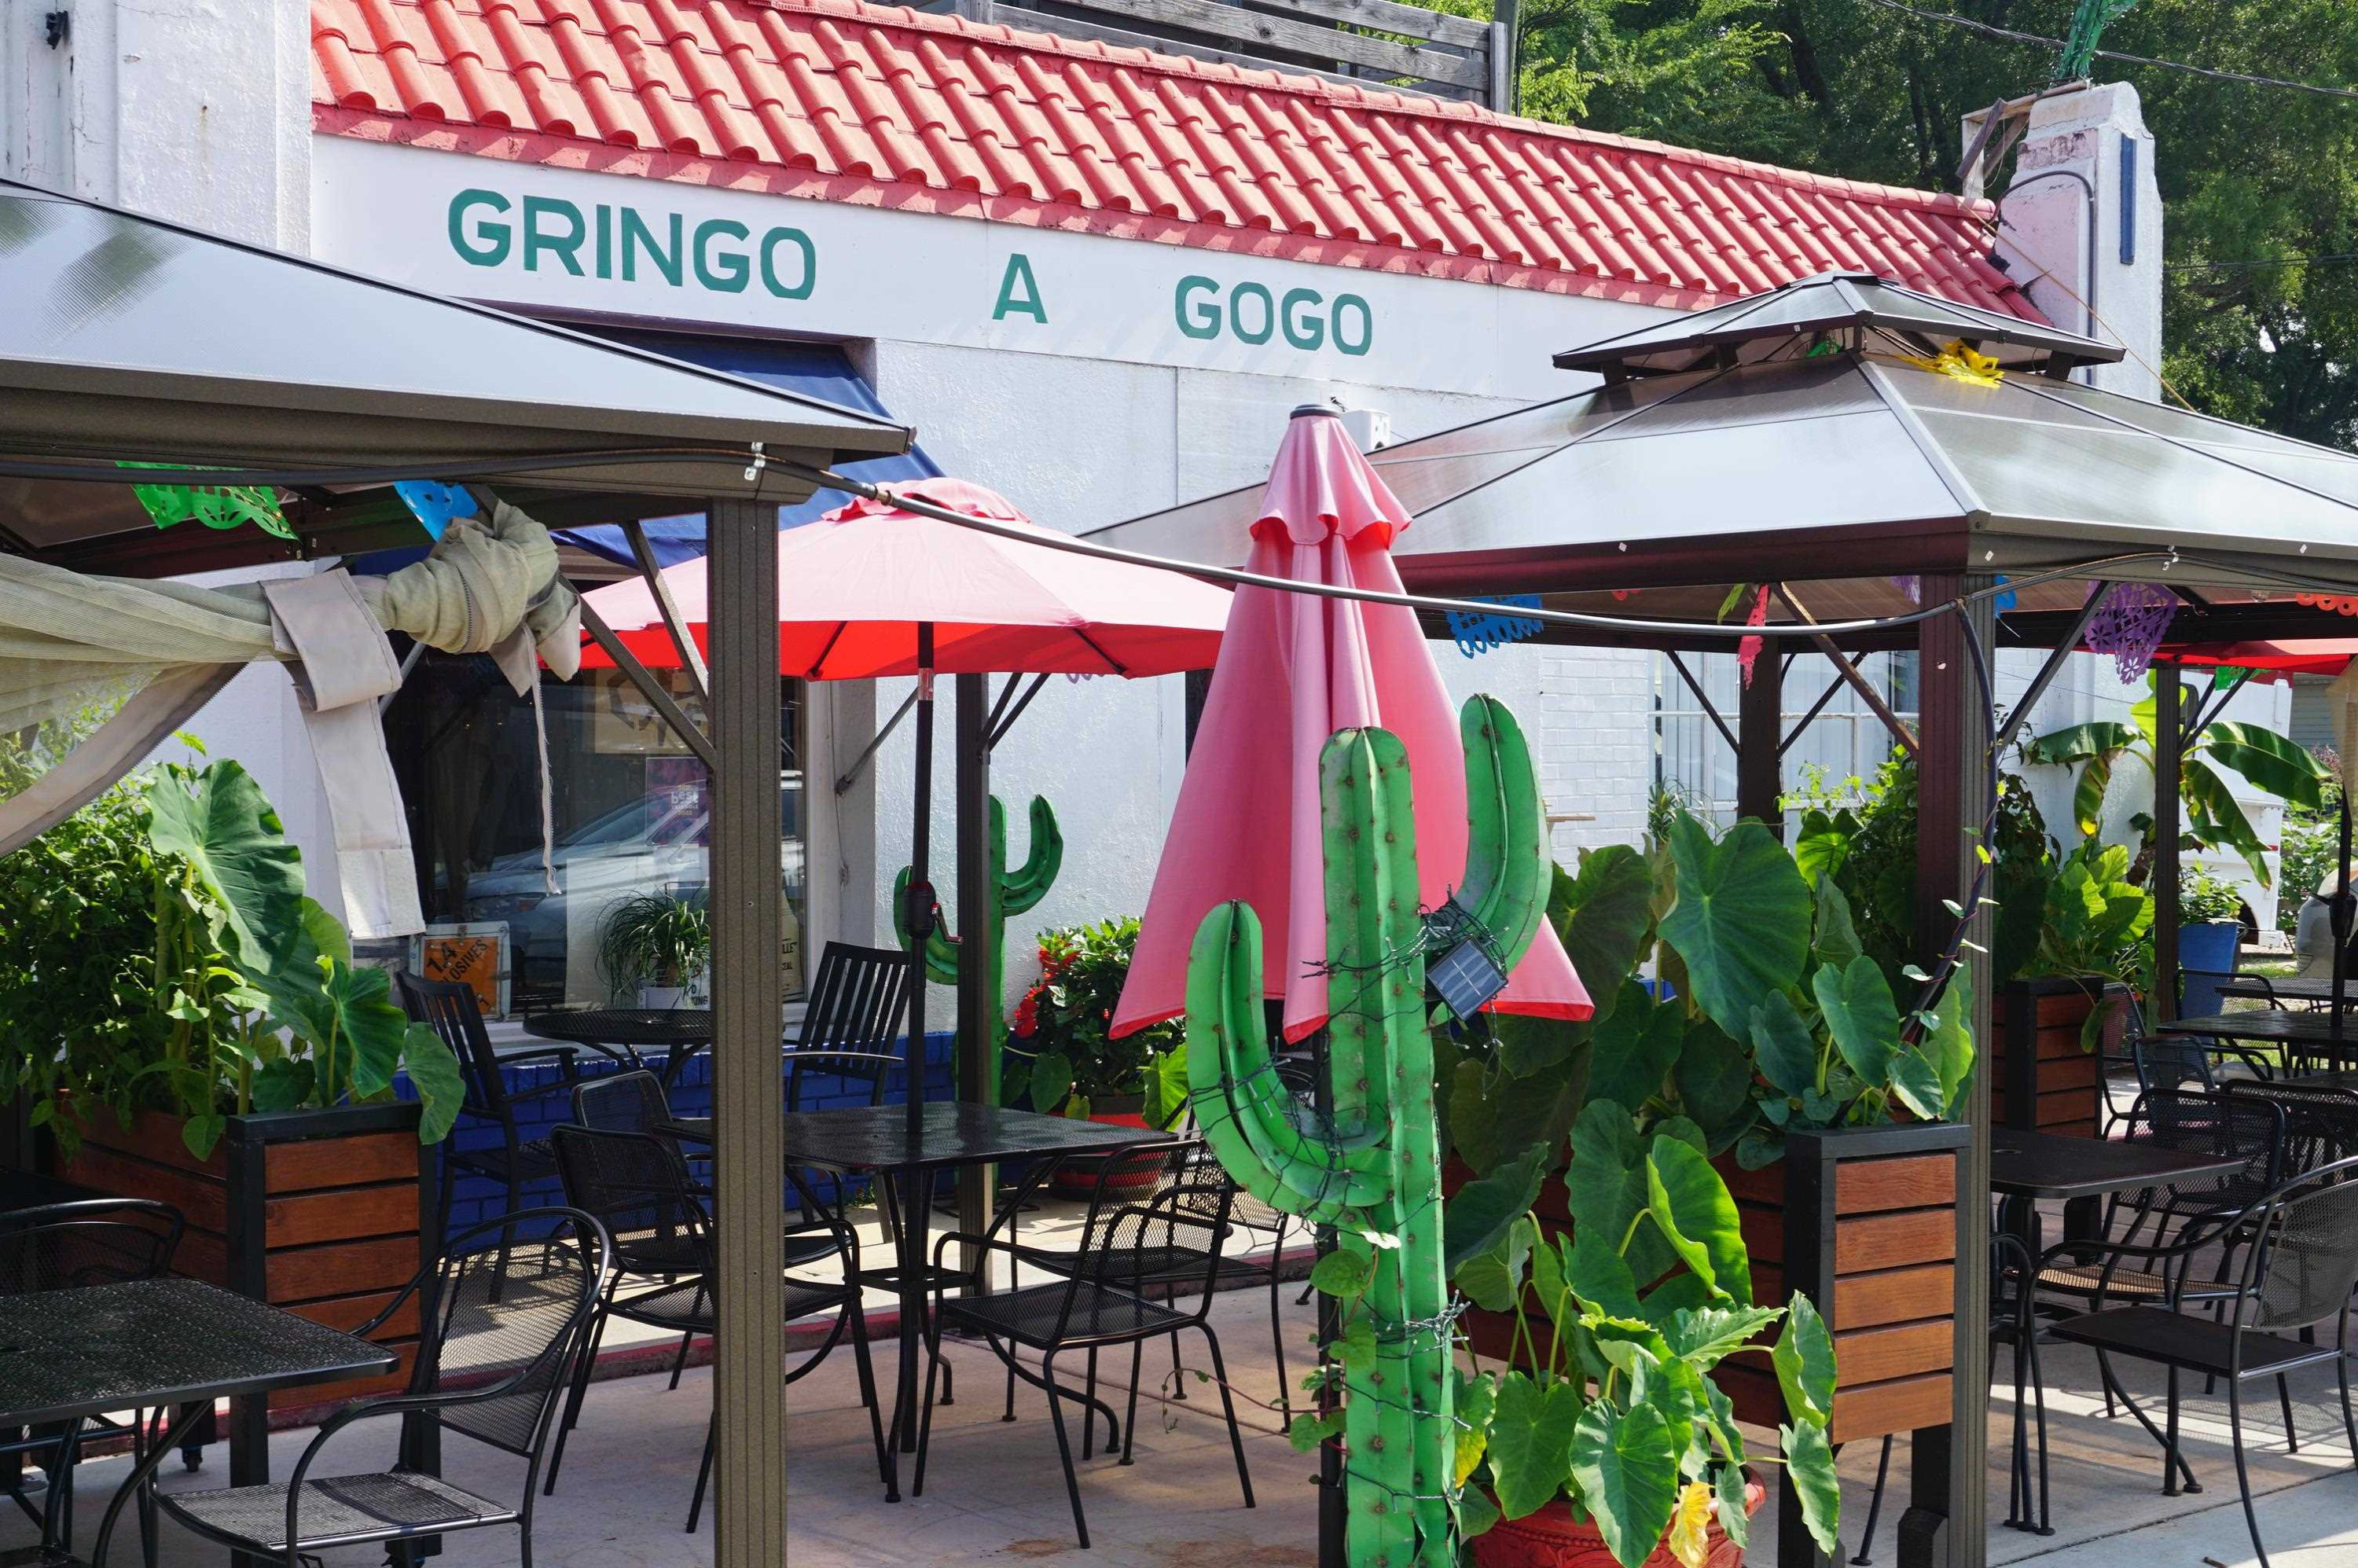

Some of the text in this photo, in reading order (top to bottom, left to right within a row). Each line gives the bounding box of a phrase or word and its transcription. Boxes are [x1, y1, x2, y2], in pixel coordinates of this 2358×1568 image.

[448, 189, 1372, 355] GRINGO A GOGO
